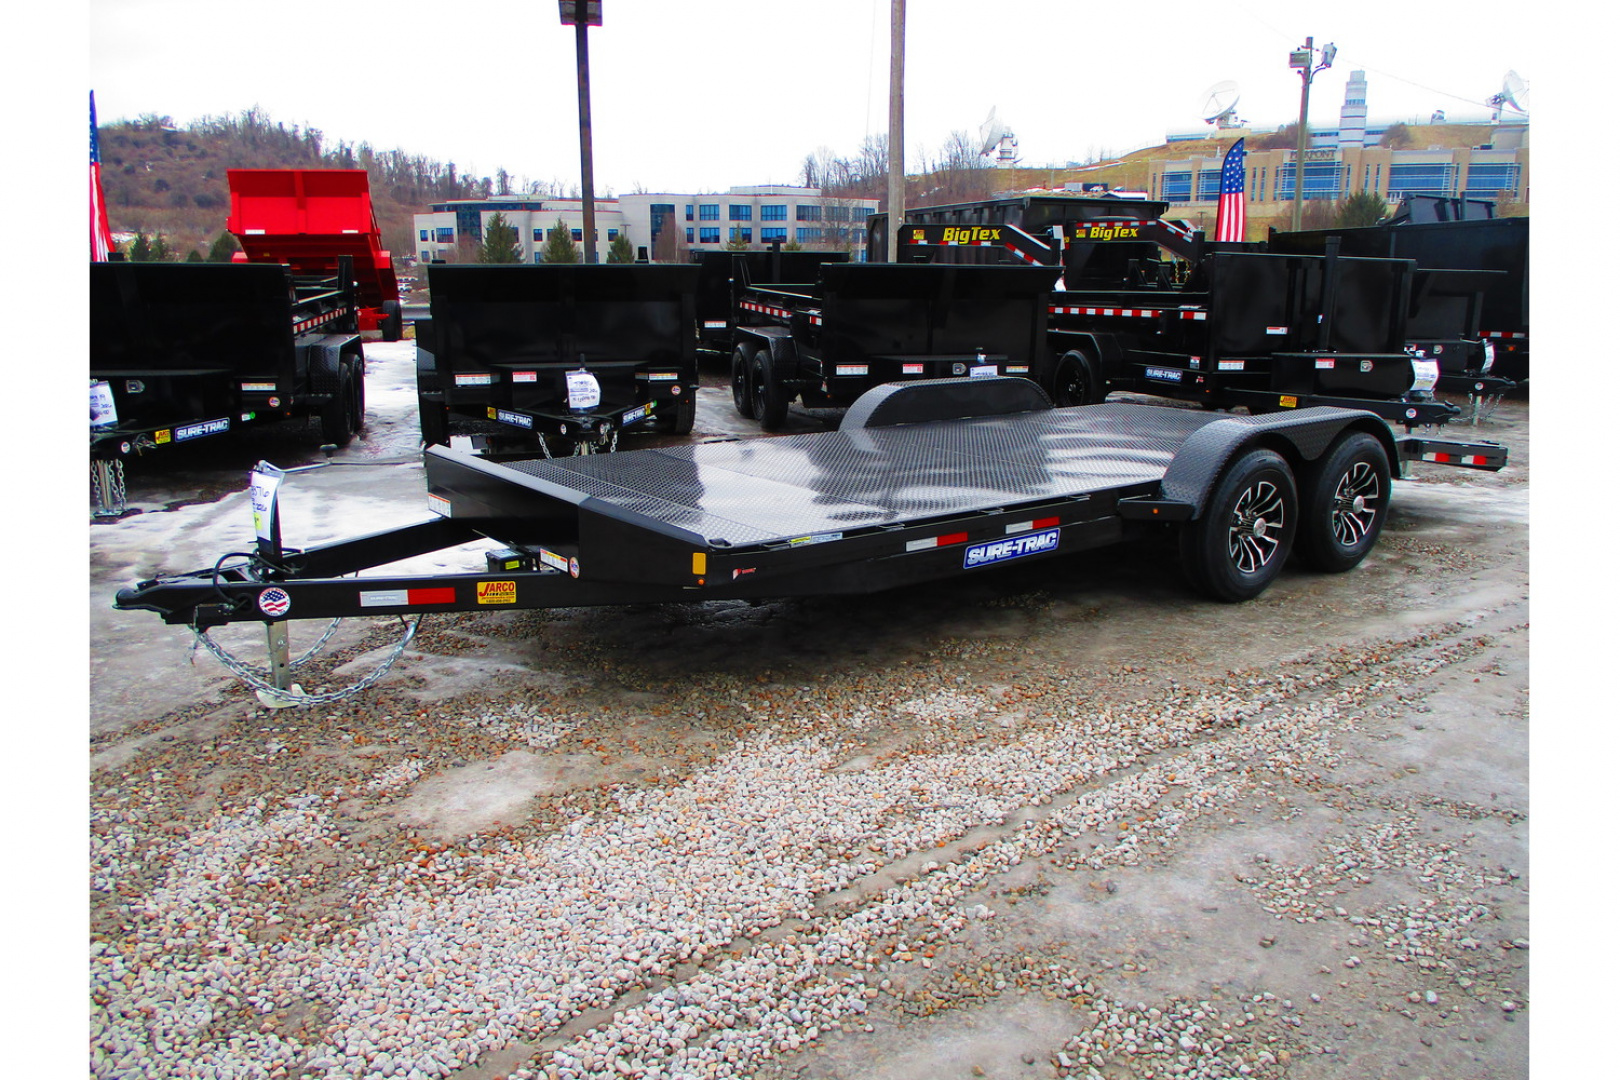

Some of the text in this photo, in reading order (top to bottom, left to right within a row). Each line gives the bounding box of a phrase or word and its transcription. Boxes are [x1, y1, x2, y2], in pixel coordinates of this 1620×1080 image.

[943, 227, 1001, 245] BigTex
[1090, 226, 1138, 241] BigTex
[1146, 368, 1181, 381] SURE-TRAC
[498, 411, 532, 428] SURE-TRAC
[177, 420, 228, 440] SURE-TRAC
[967, 531, 1057, 564] SURE-TRAC
[478, 582, 514, 597] JARCO
